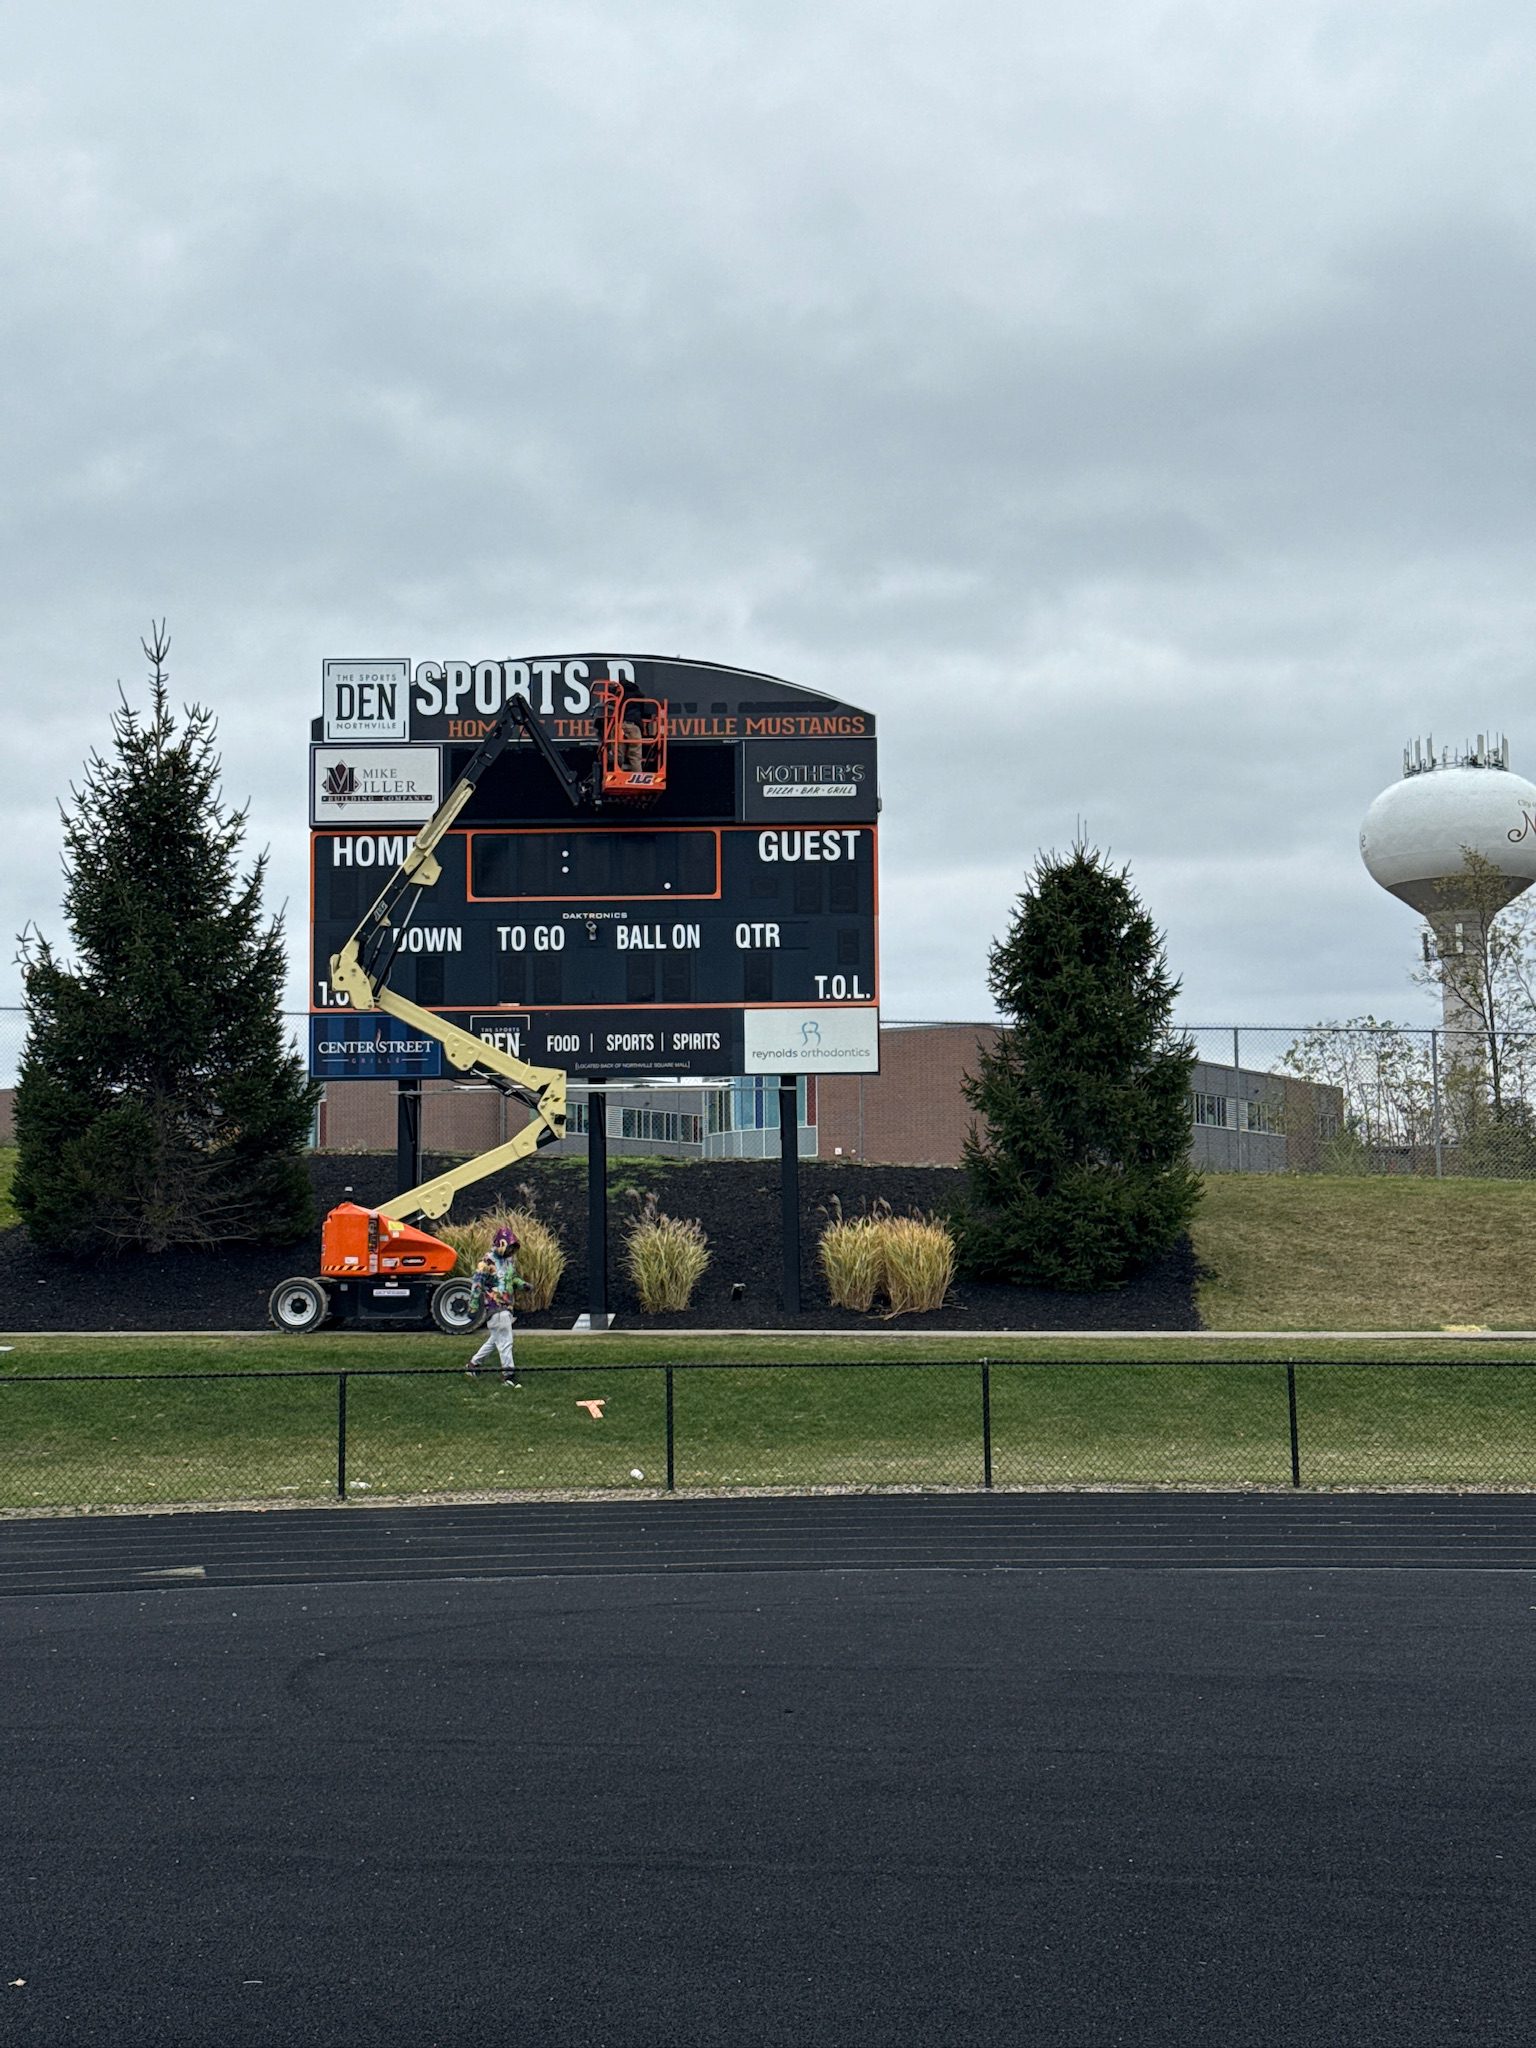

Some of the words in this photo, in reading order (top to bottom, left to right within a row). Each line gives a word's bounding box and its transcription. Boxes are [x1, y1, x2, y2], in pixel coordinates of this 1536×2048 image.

[416, 660, 590, 715] SPORTS
[335, 683, 397, 720] DEN
[449, 720, 498, 737] HOM
[554, 720, 597, 737] THE
[745, 717, 865, 736] MUSTANGS
[362, 769, 398, 778] MIKE
[627, 774, 654, 784] JLG
[756, 764, 865, 782] MOTHER'S
[766, 787, 794, 796] PIZZA
[801, 786, 820, 795] BAR
[827, 786, 854, 795] GRILL
[758, 830, 861, 862] GUEST
[392, 926, 462, 952] DOWN
[497, 926, 526, 951] TO
[534, 925, 565, 951] GO
[616, 924, 667, 950] BALL
[672, 924, 700, 949] ON
[735, 923, 781, 949] QTR
[814, 975, 871, 1000] T.O.L.
[318, 1041, 376, 1054] CENTER
[376, 1036, 434, 1053] STREET
[546, 1034, 580, 1051] FOOD
[606, 1033, 655, 1051] SPORTS
[672, 1032, 721, 1050] SPIRITS
[752, 1049, 799, 1060] reynolds
[800, 1047, 871, 1058] orthodontics
